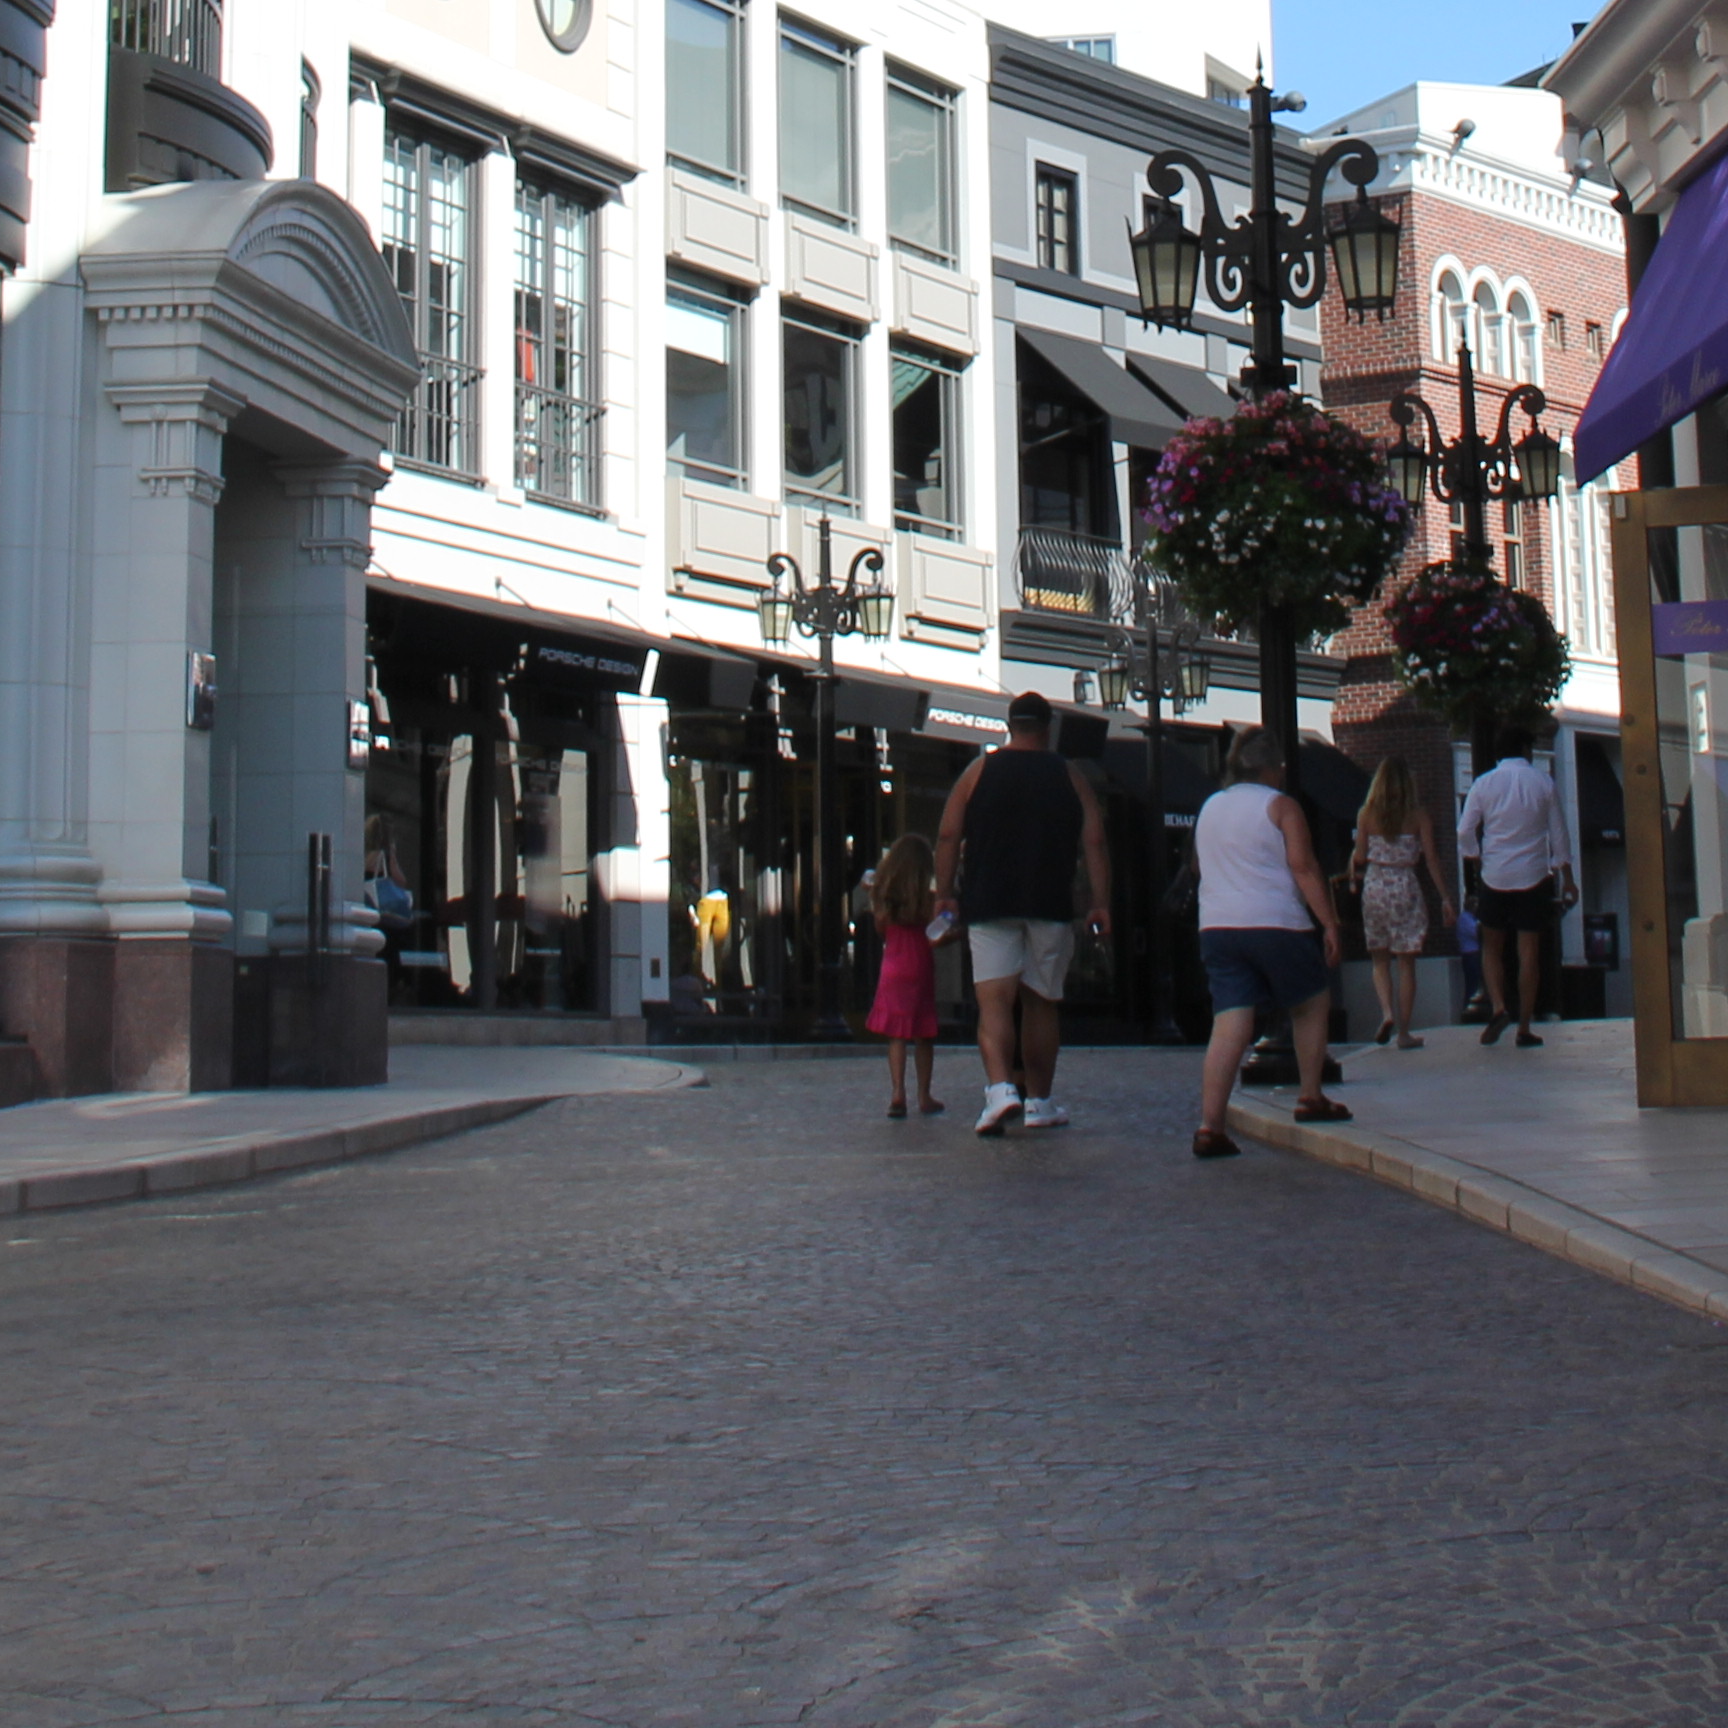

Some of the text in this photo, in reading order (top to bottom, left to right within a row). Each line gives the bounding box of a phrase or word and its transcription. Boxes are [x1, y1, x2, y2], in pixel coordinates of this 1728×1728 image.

[538, 647, 640, 676] PORSCHE DESIGN
[928, 707, 974, 728] PORSCHE
